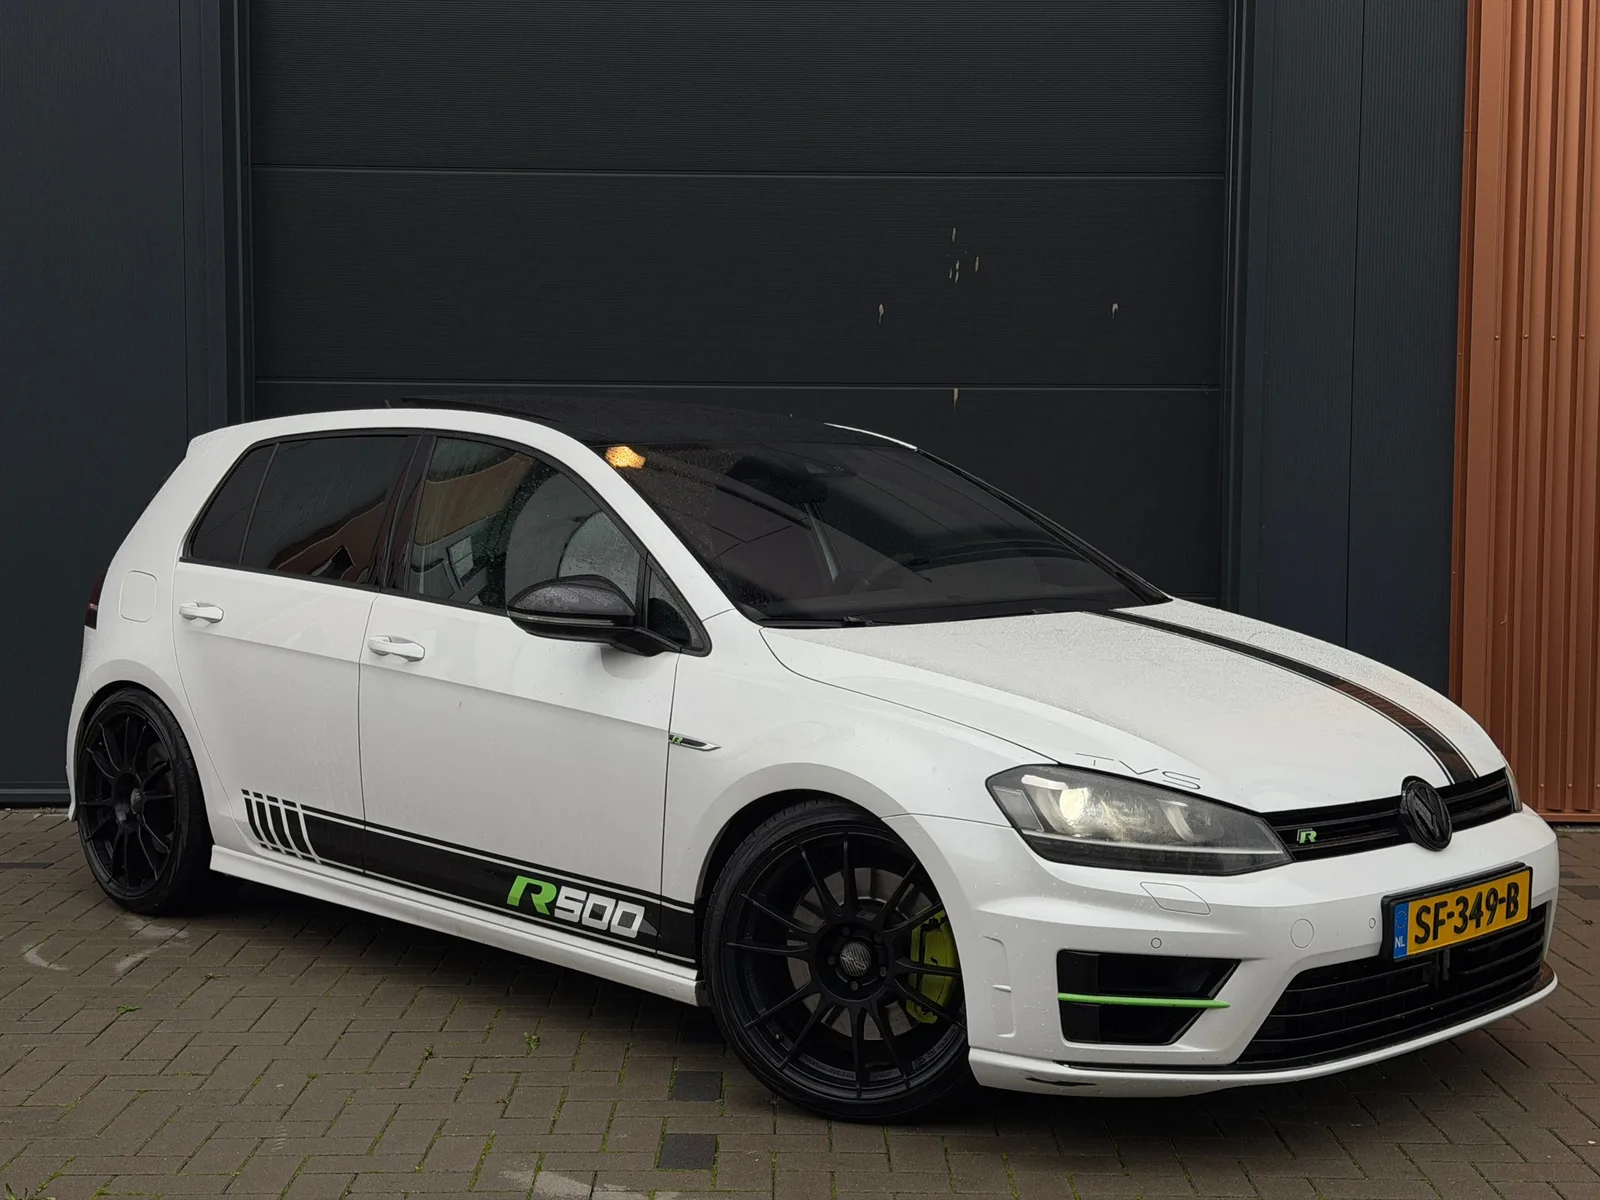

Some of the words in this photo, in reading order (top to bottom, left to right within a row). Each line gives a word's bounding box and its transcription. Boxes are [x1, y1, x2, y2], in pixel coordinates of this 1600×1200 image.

[1074, 752, 1201, 790] TVS
[1298, 829, 1317, 844] R
[506, 874, 646, 939] R500
[1414, 881, 1520, 945] SF-349-B
[1394, 935, 1406, 949] NL
